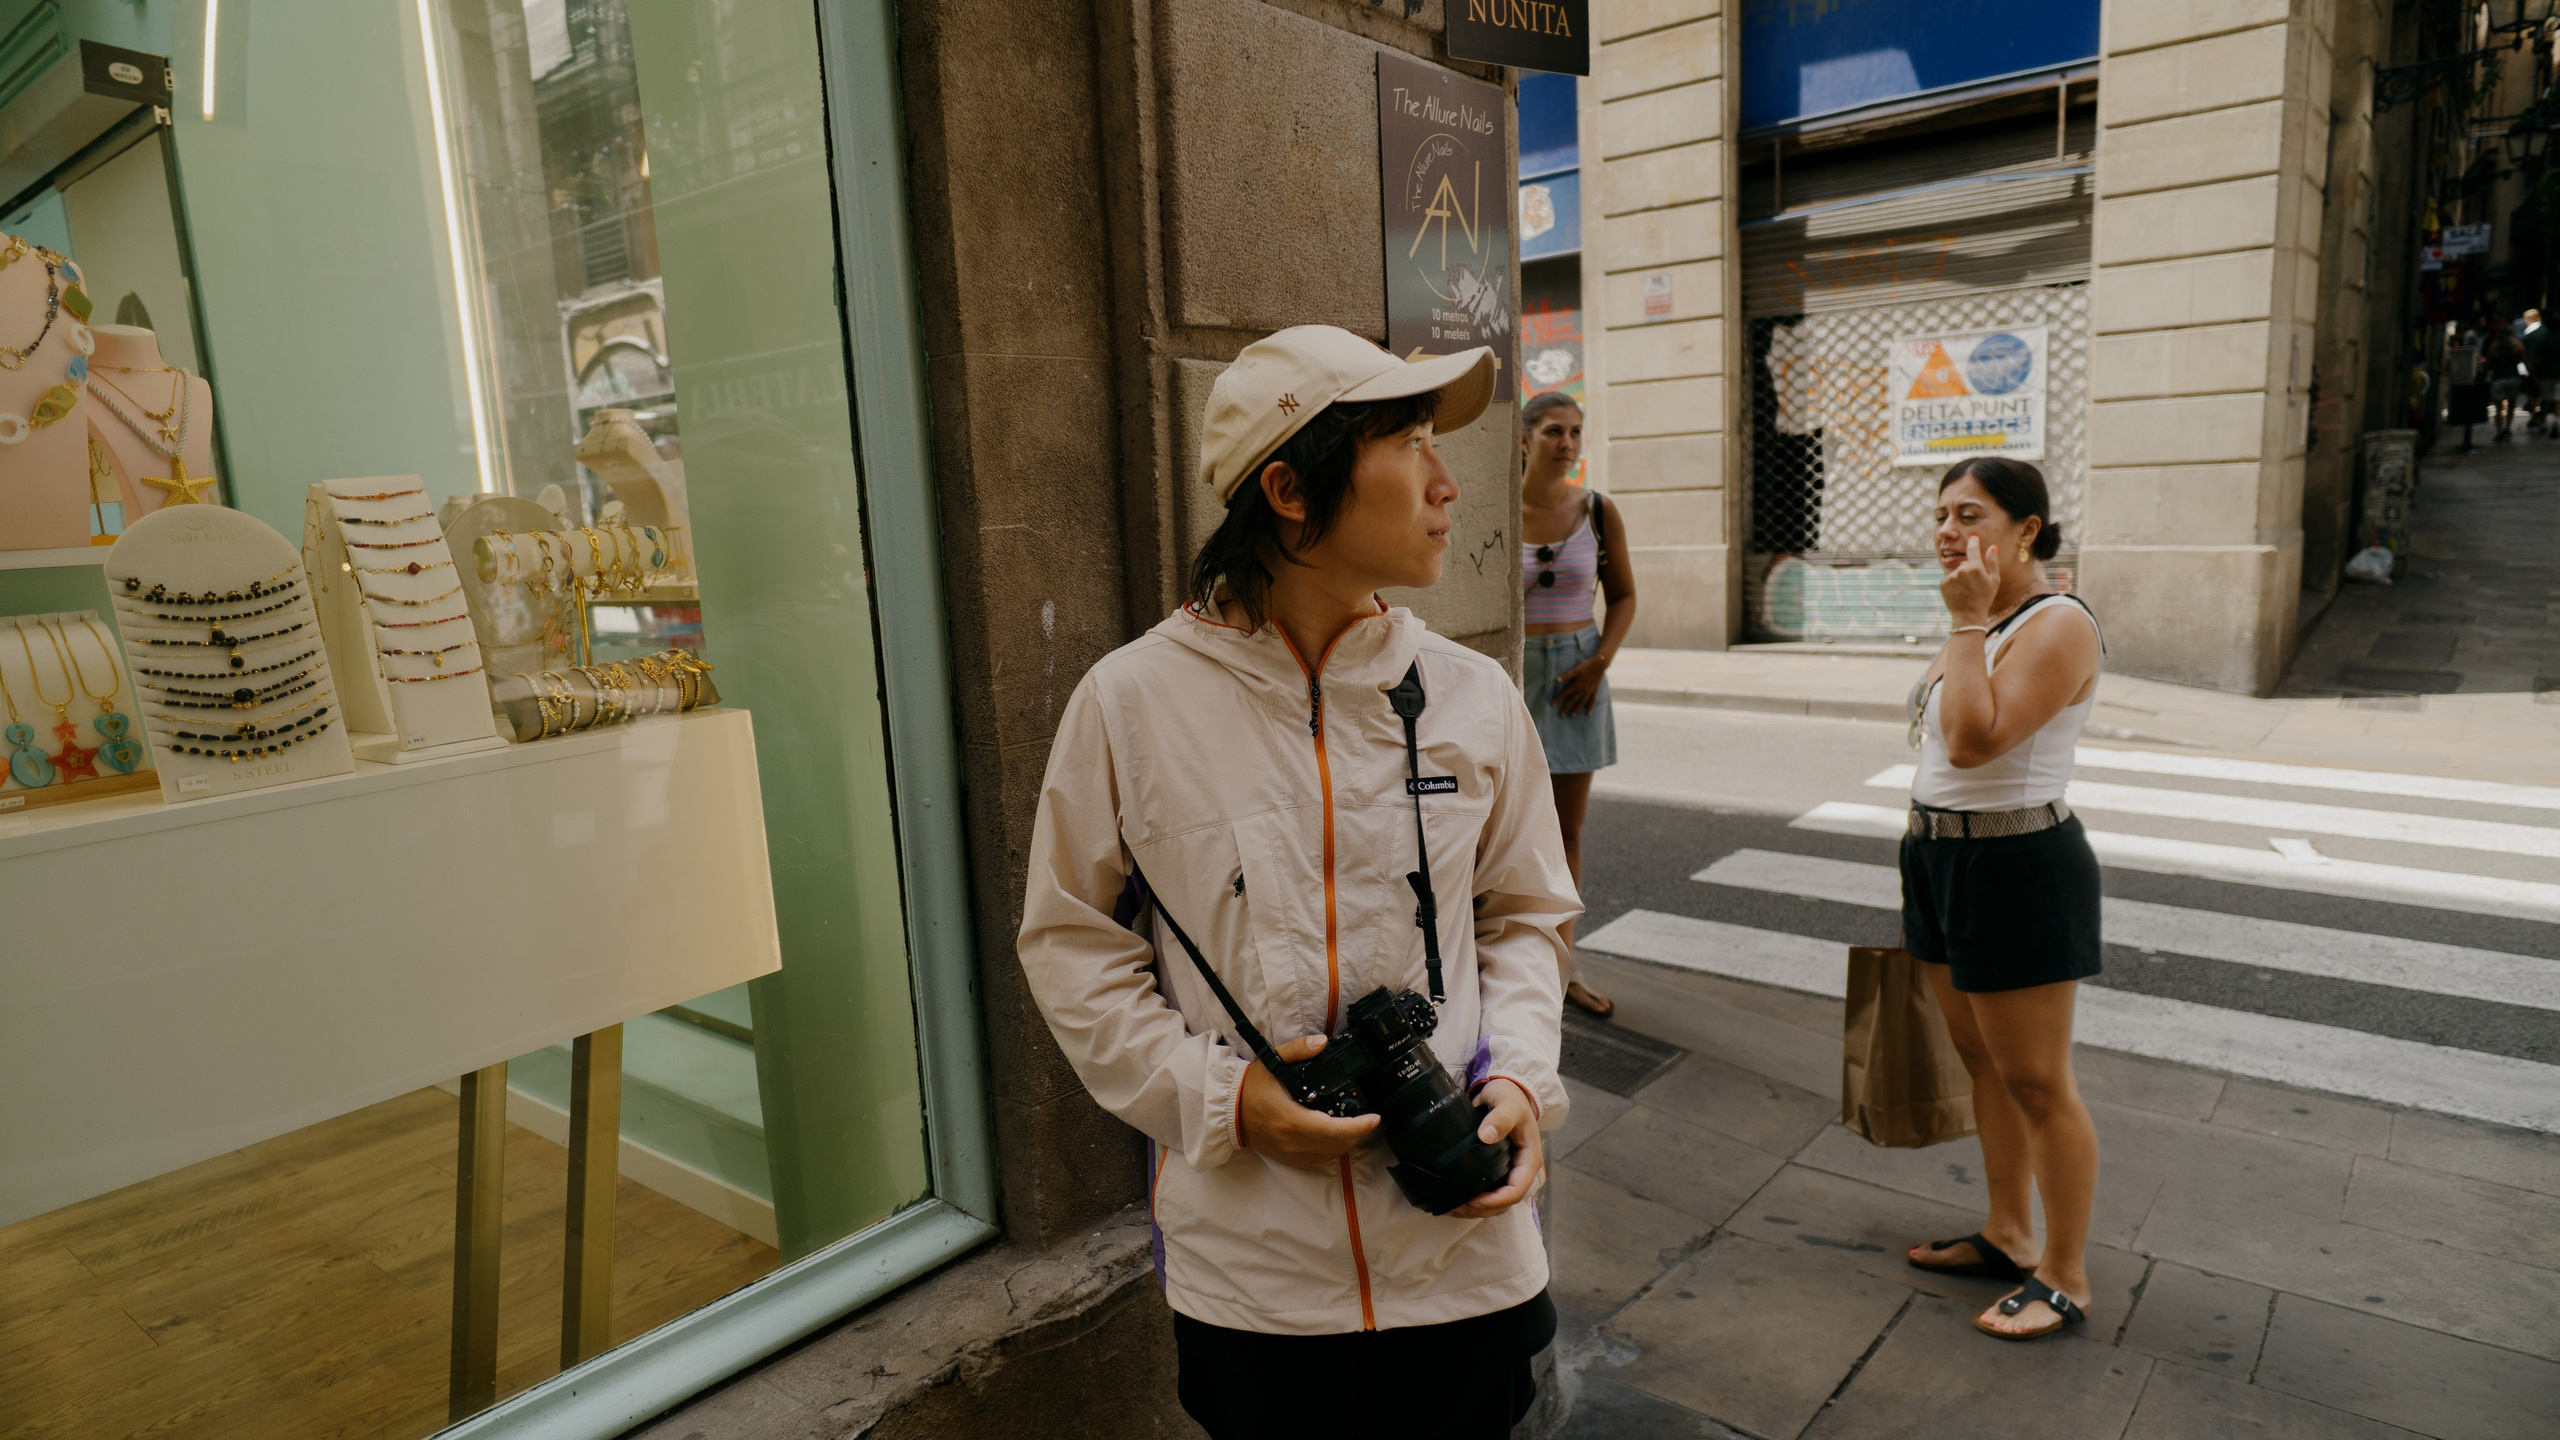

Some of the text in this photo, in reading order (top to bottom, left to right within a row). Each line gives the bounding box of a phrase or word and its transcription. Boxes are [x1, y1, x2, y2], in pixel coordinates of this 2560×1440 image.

[1467, 0, 1573, 37] NUNITA
[1393, 87, 1494, 135] The Allure Nails
[1411, 140, 1453, 213] The Allure Nails
[1431, 308, 1469, 323] 10 metros
[1431, 326, 1471, 341] 10 meters
[1902, 398, 2032, 421] DELTA PUNT
[1417, 780, 1456, 791] Columbia
[1388, 1033, 1411, 1051] Nikon
